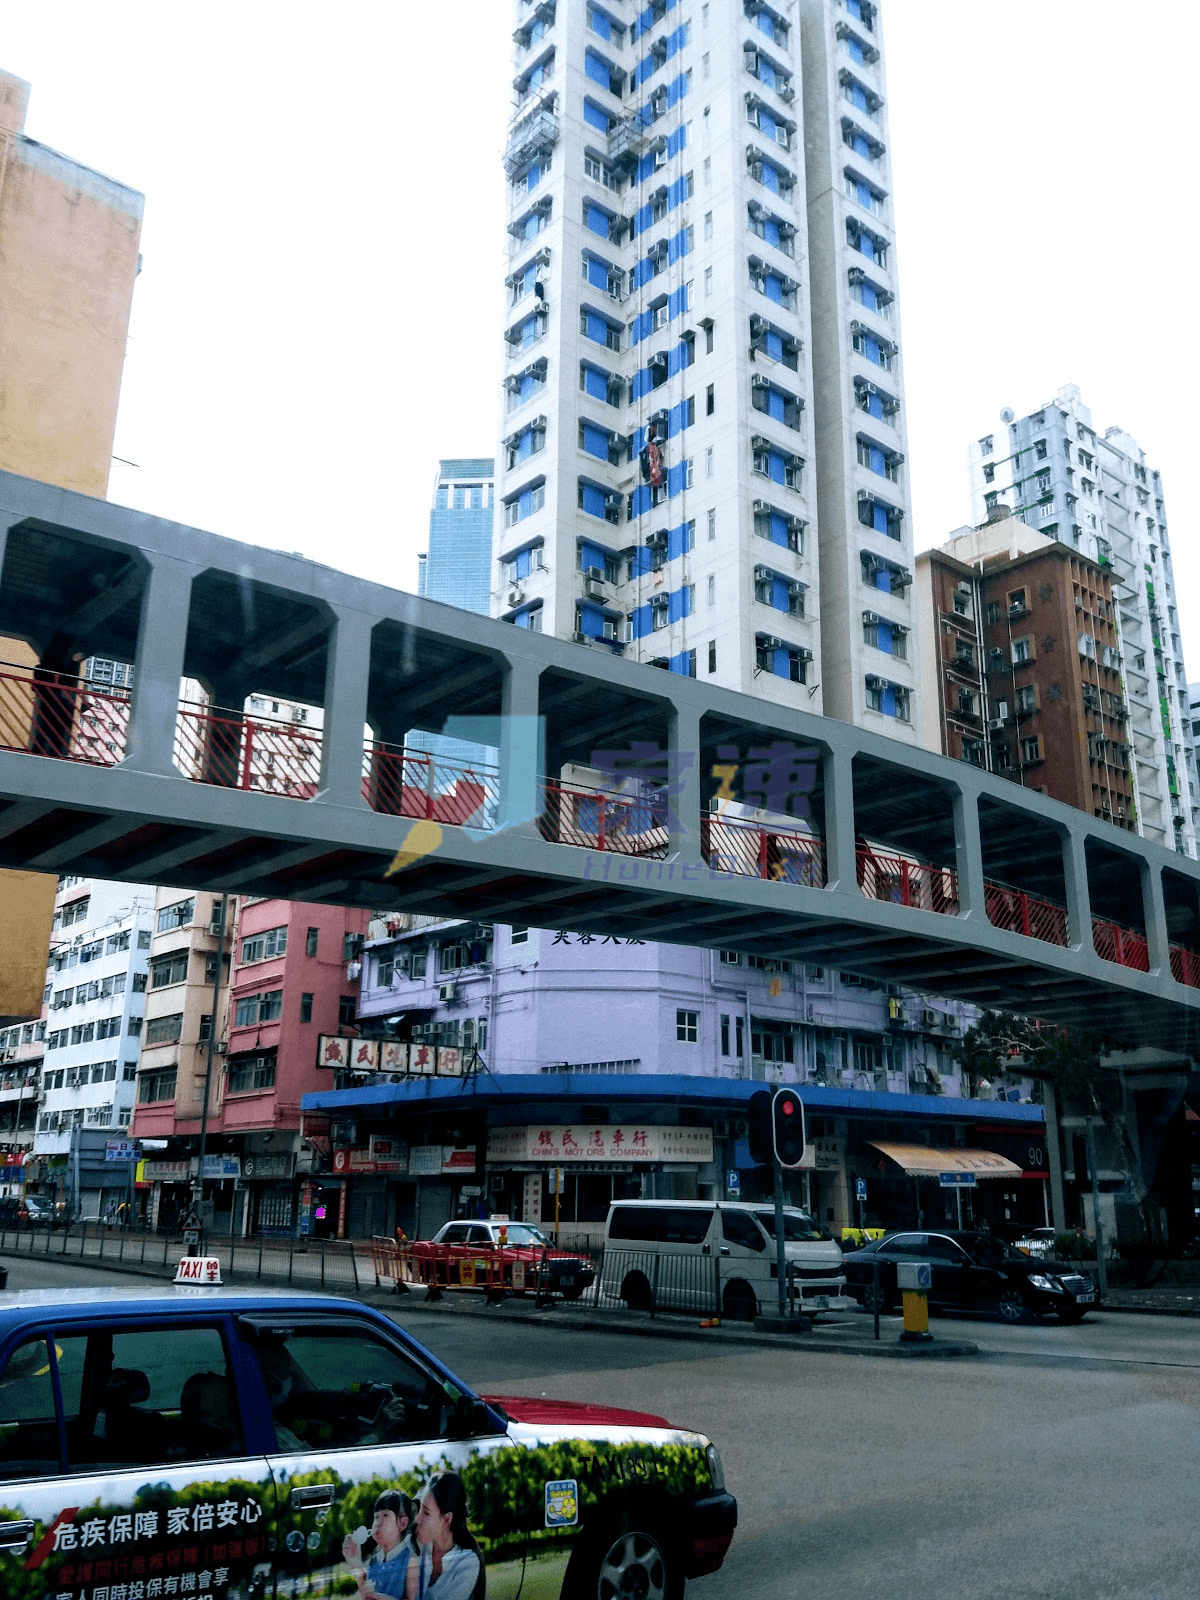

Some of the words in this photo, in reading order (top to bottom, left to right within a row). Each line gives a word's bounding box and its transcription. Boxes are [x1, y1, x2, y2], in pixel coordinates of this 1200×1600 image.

[565, 1147, 605, 1156] MOTORS
[610, 1147, 654, 1156] COMPANY
[1028, 1147, 1043, 1165] 90
[729, 1173, 737, 1187] P
[858, 1181, 864, 1193] P
[179, 1261, 203, 1278] TAXI
[206, 1261, 218, 1281] 的士
[579, 1456, 624, 1481] TAXI
[52, 1510, 158, 1552] 危疾保障
[167, 1497, 263, 1535] 家倍安心
